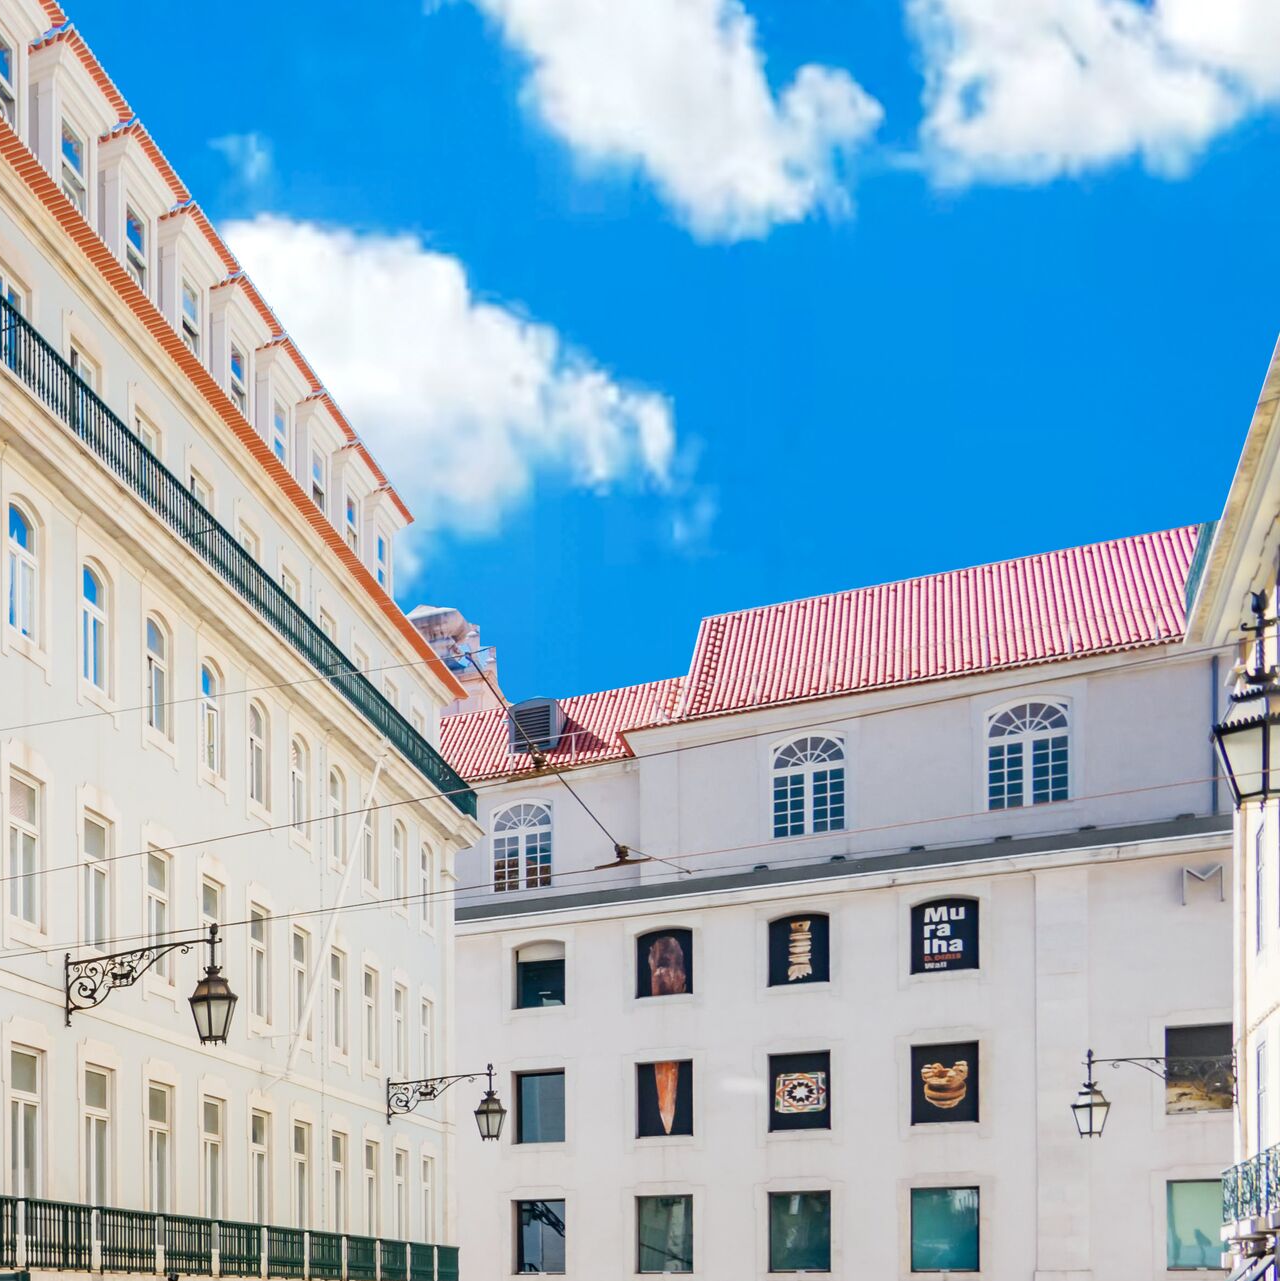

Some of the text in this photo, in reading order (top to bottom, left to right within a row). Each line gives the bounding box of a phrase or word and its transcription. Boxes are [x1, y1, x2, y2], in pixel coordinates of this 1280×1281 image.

[924, 906, 965, 923] Mu
[924, 923, 951, 938] ra
[924, 939, 963, 954] lha
[924, 961, 947, 969] Wall
